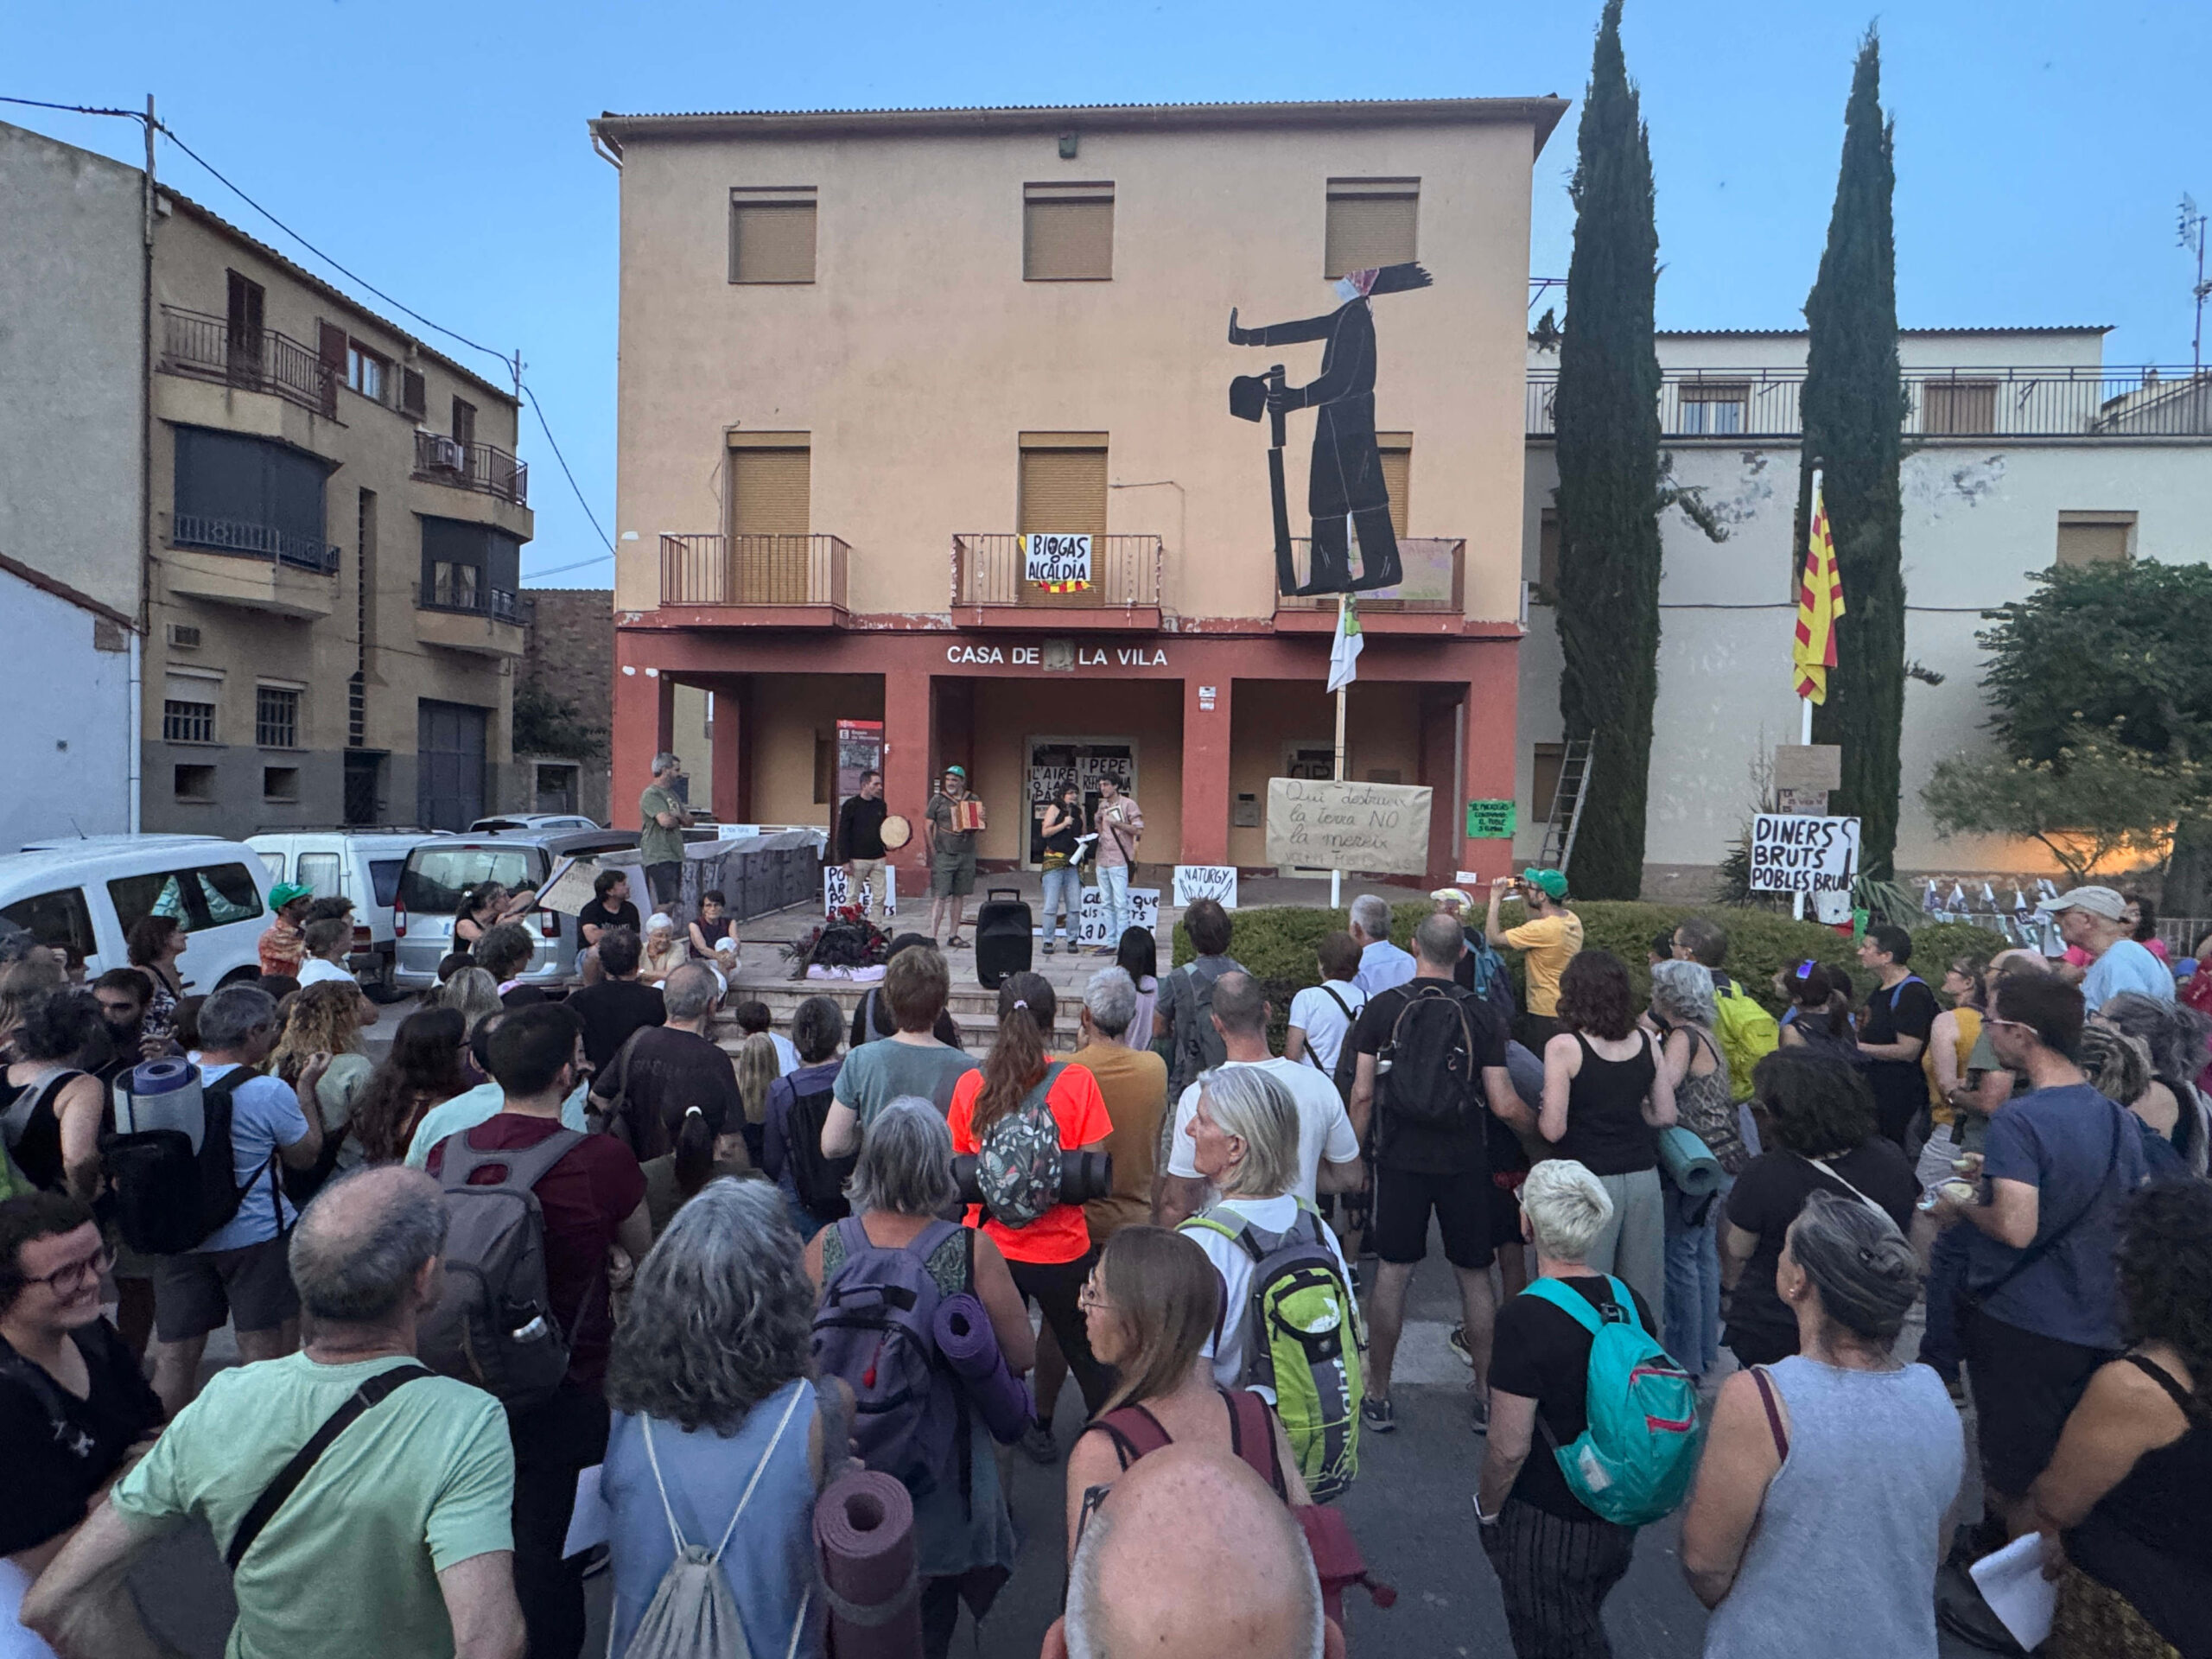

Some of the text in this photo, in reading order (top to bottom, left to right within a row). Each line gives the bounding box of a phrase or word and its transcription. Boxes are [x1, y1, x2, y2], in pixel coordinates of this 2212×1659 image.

[1034, 535, 1089, 558] BIOGAS
[947, 645, 1168, 666] CASA DE LA VILA
[1090, 759, 1127, 774] PEPE
[1286, 781, 1324, 802] Qui
[1289, 804, 1306, 823] la
[1370, 810, 1400, 828] NO
[1289, 823, 1309, 844] la
[1757, 817, 1838, 848] DINERS
[1755, 845, 1827, 869] BRUTS
[1185, 868, 1230, 886] NATURGY
[1751, 867, 1811, 892] POBLES
[1133, 895, 1159, 910] que
